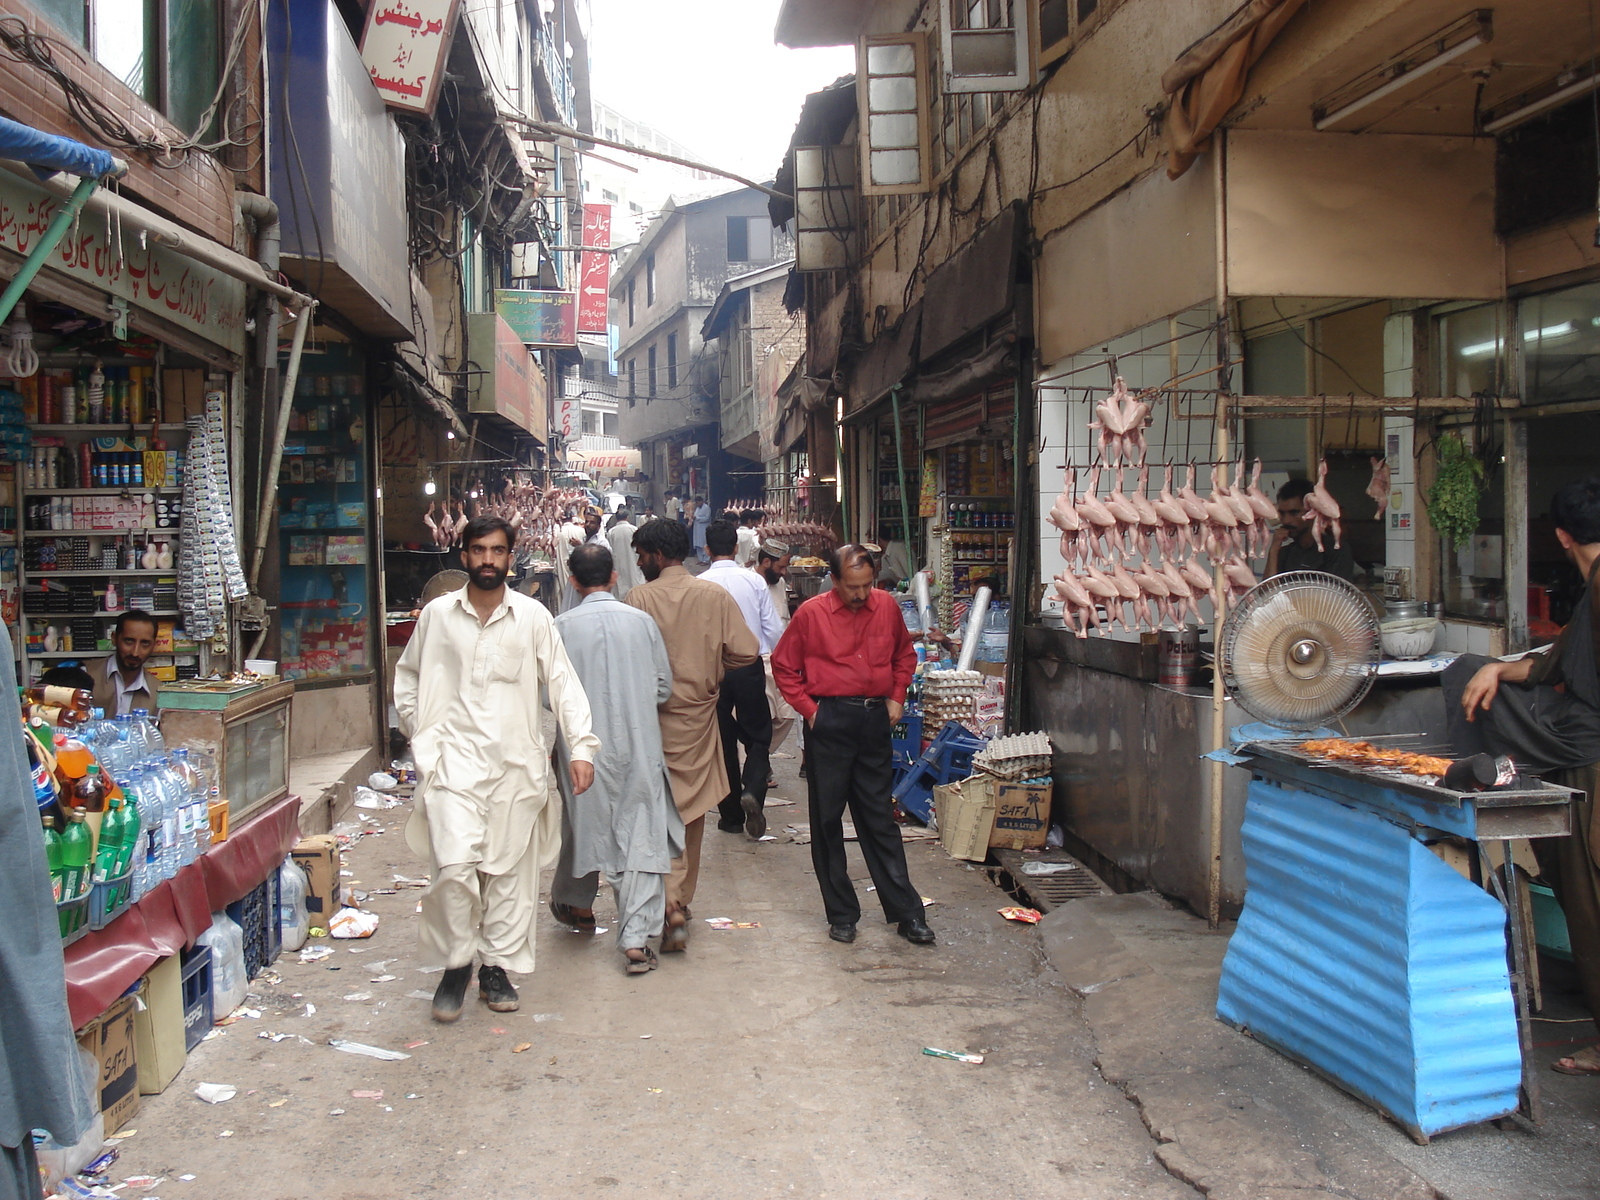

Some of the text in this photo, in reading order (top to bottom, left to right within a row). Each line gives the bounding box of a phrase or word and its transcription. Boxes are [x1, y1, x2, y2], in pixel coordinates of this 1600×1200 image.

[392, 43, 413, 69] اینڈ
[371, 65, 427, 98] کیمسٹ
[327, 60, 370, 174] SUPER
[128, 246, 167, 300] شاپ
[553, 294, 573, 306] لاہور
[561, 401, 570, 436] PCO
[588, 456, 628, 468] HOTEL
[980, 702, 998, 710] DAWN
[999, 805, 1029, 816] SAFA
[184, 1003, 203, 1028] PEPSI
[104, 1046, 128, 1081] SAFA
